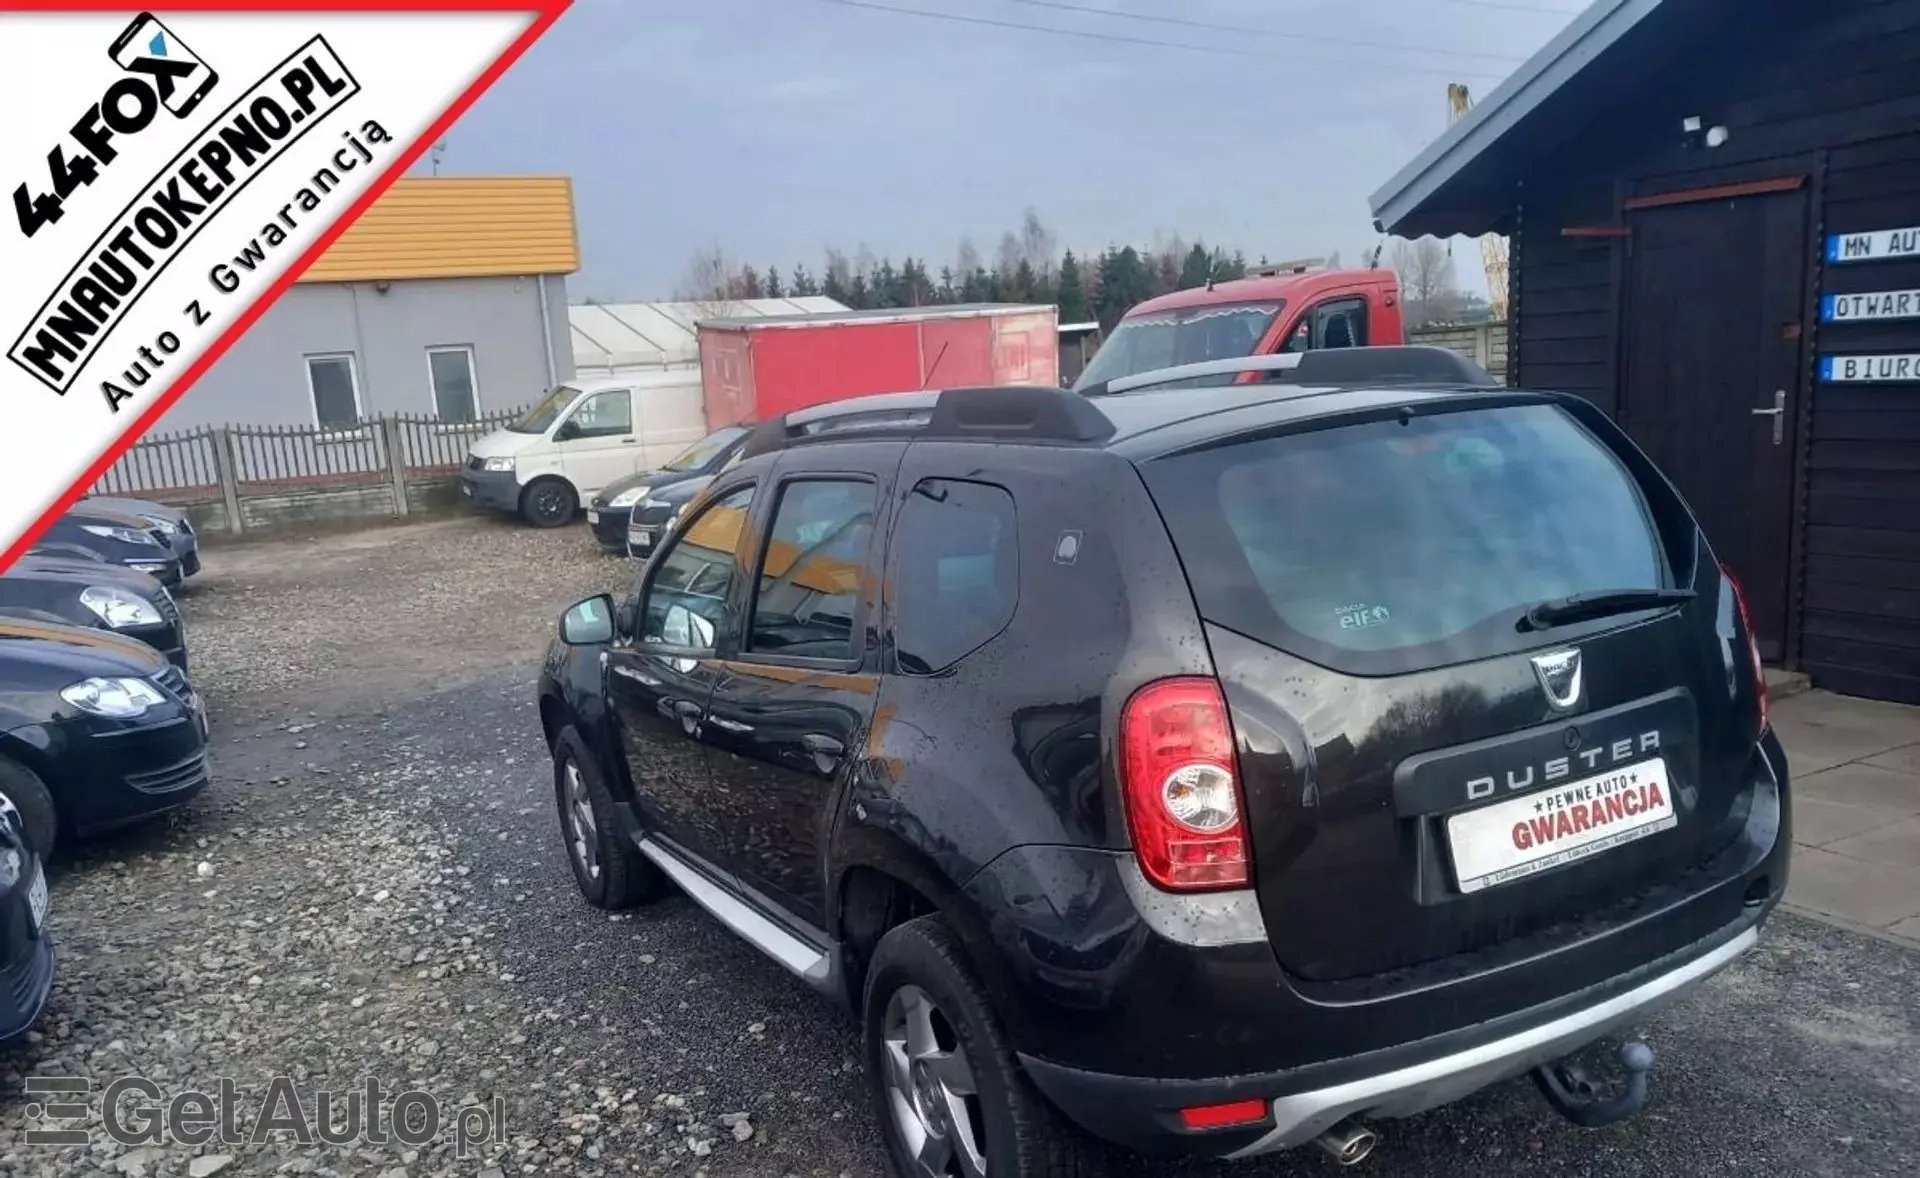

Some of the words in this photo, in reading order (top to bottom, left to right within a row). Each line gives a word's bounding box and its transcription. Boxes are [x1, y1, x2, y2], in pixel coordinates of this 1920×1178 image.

[1844, 235, 1872, 257] MN
[1887, 230, 1920, 254] AU
[1466, 730, 1660, 800] DUSTER
[1511, 781, 1665, 851] GWARANCJA
[1546, 785, 1592, 810] PEWNE
[1596, 775, 1627, 796] AUTO
